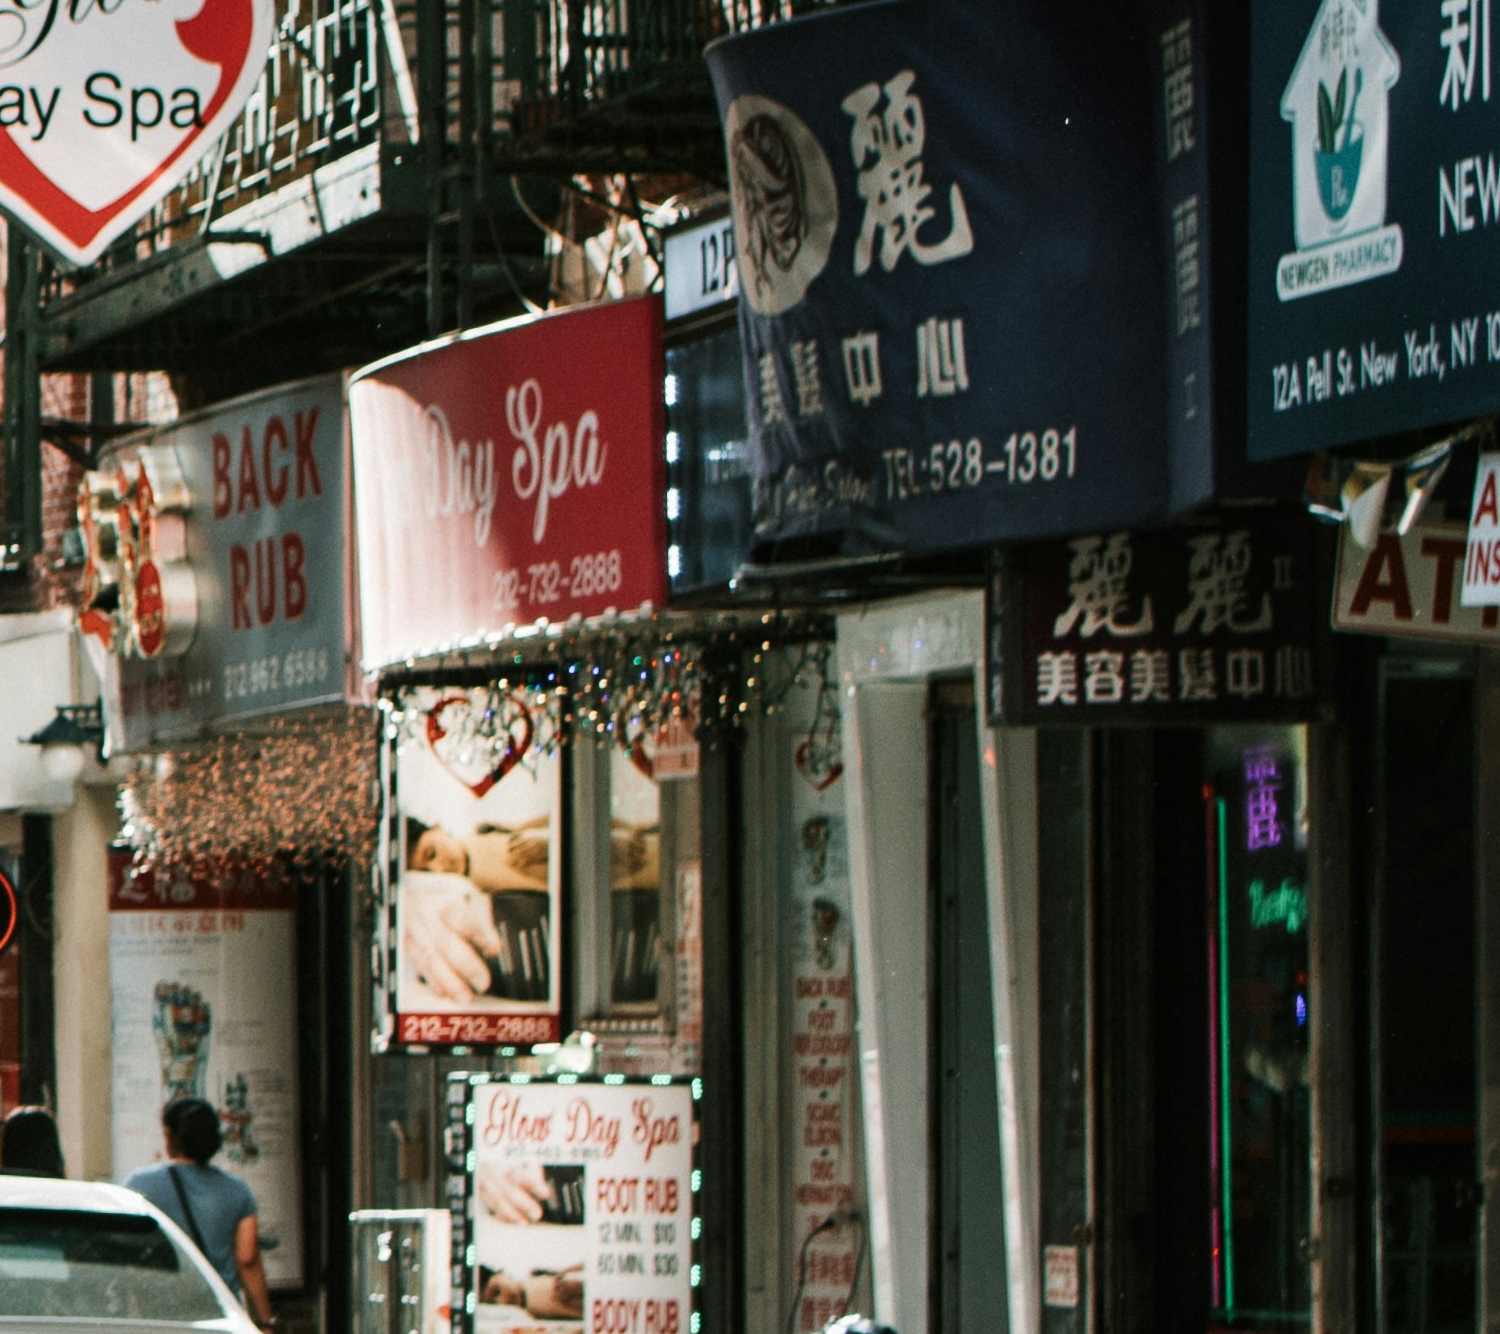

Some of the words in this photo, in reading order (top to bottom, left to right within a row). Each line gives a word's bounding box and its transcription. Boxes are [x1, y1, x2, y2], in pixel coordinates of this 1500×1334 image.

[82, 72, 206, 142] Spa
[1332, 236, 1398, 279] PHARMACY
[1307, 349, 1332, 404] Pell
[1361, 341, 1397, 391] New
[1405, 323, 1445, 381] York,
[1451, 315, 1479, 365] NY
[212, 407, 324, 523] BACK
[426, 404, 498, 548] Day
[506, 378, 608, 545] Spa
[228, 532, 309, 632] RUB
[1349, 534, 1500, 629] AT
[1466, 540, 1500, 586] INS
[404, 1017, 551, 1039] 212-732-2888
[482, 1090, 553, 1147] Glow
[566, 1096, 622, 1157] Day
[631, 1094, 681, 1161] Spa
[596, 1177, 640, 1213] FOOT
[645, 1177, 679, 1213] RUB
[653, 1222, 677, 1245] $10
